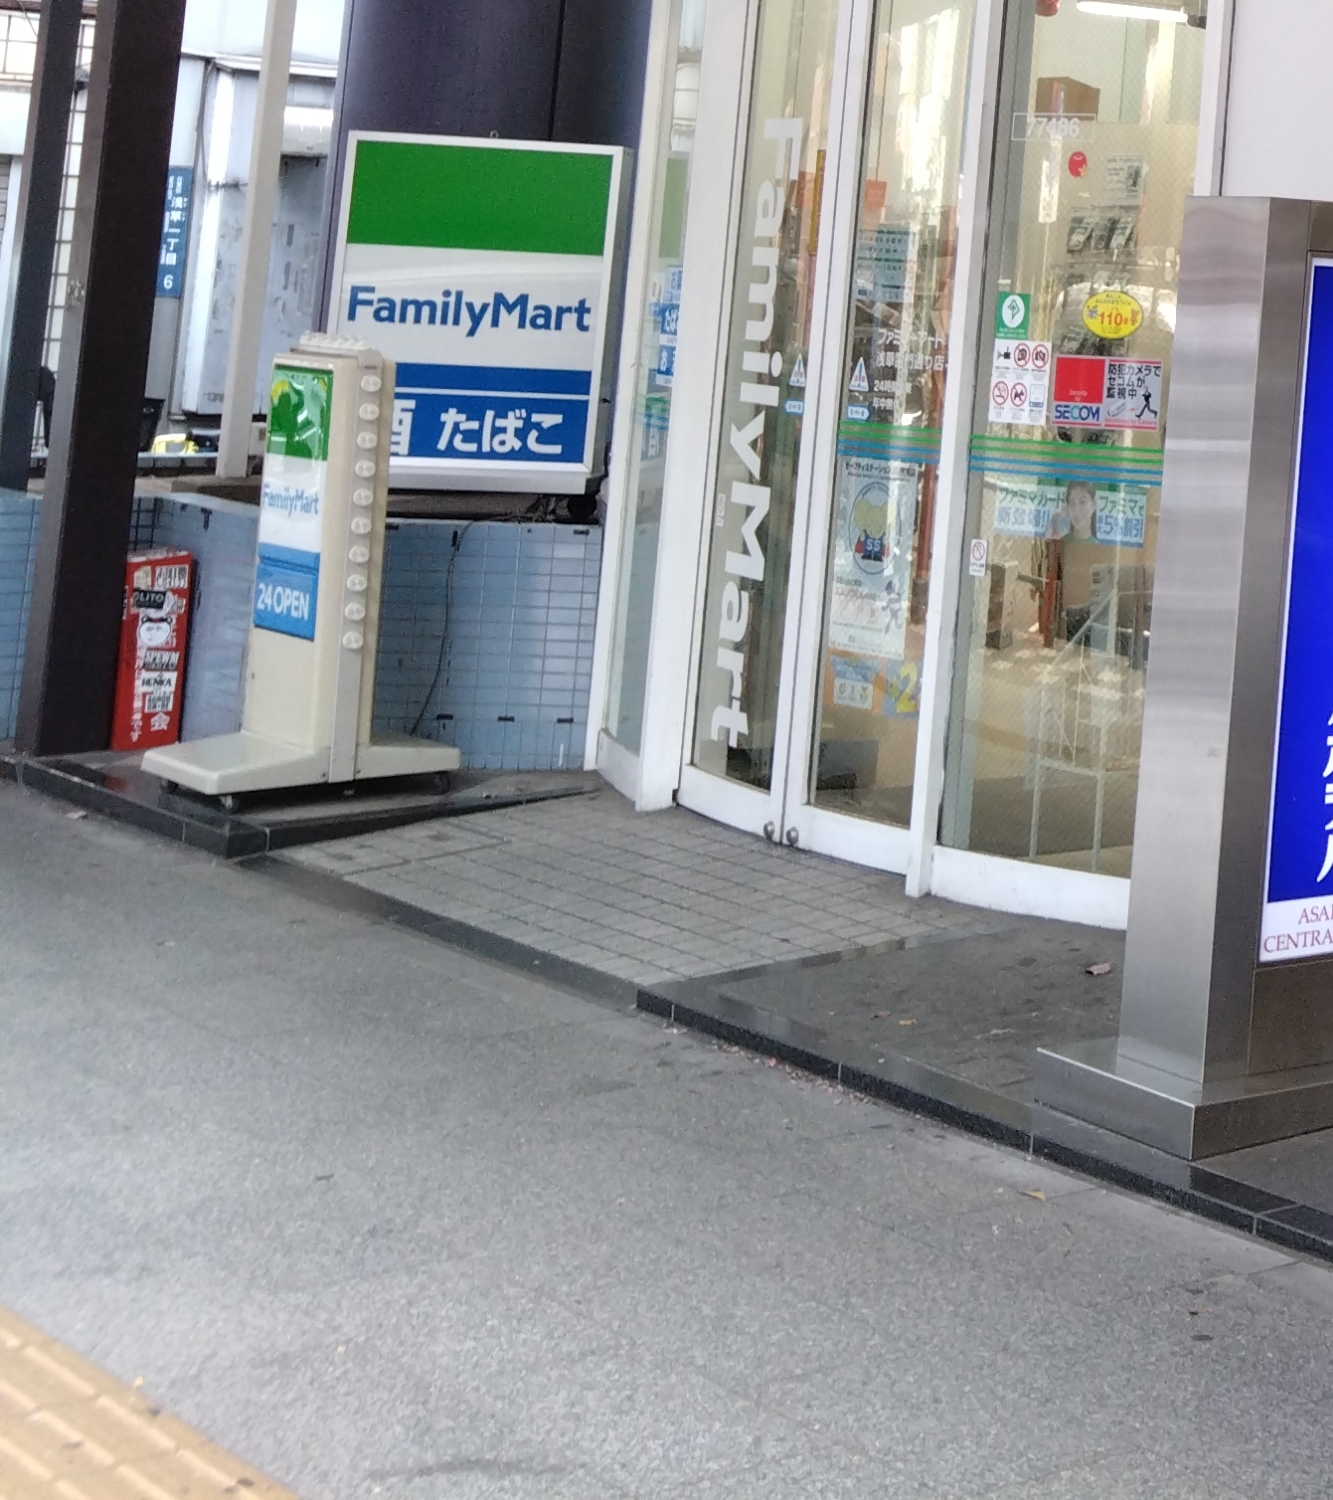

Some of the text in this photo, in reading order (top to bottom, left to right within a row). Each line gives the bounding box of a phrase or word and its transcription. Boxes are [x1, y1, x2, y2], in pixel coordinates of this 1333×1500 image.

[163, 274, 174, 290] 6
[347, 284, 592, 338] FamilyMart
[1108, 363, 1162, 377] 防犯カメラで
[1054, 404, 1101, 421] SECOM
[436, 407, 564, 455] たばこ
[710, 117, 804, 750] FamilyMart
[262, 484, 320, 517] FamilyMart
